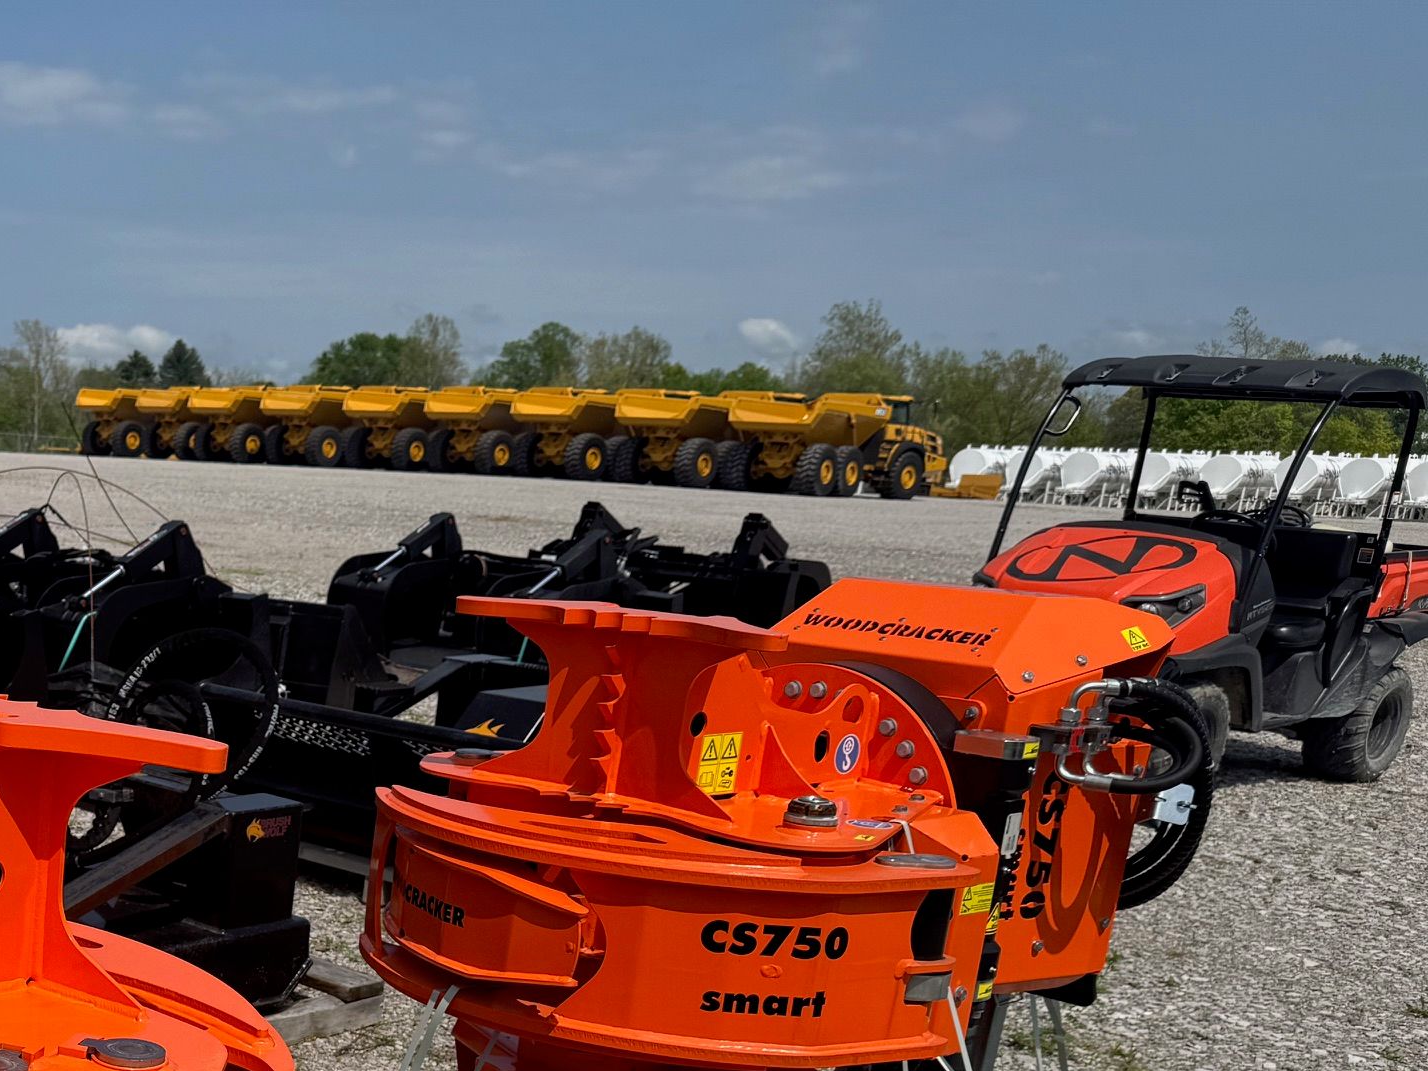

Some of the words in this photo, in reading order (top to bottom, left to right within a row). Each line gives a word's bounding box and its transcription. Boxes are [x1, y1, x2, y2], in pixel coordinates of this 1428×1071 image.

[803, 612, 993, 647] WOODCRACKER
[1019, 771, 1069, 920] CS750
[403, 883, 465, 929] CRACKER
[700, 919, 849, 961] CS750
[699, 990, 826, 1018] smart
